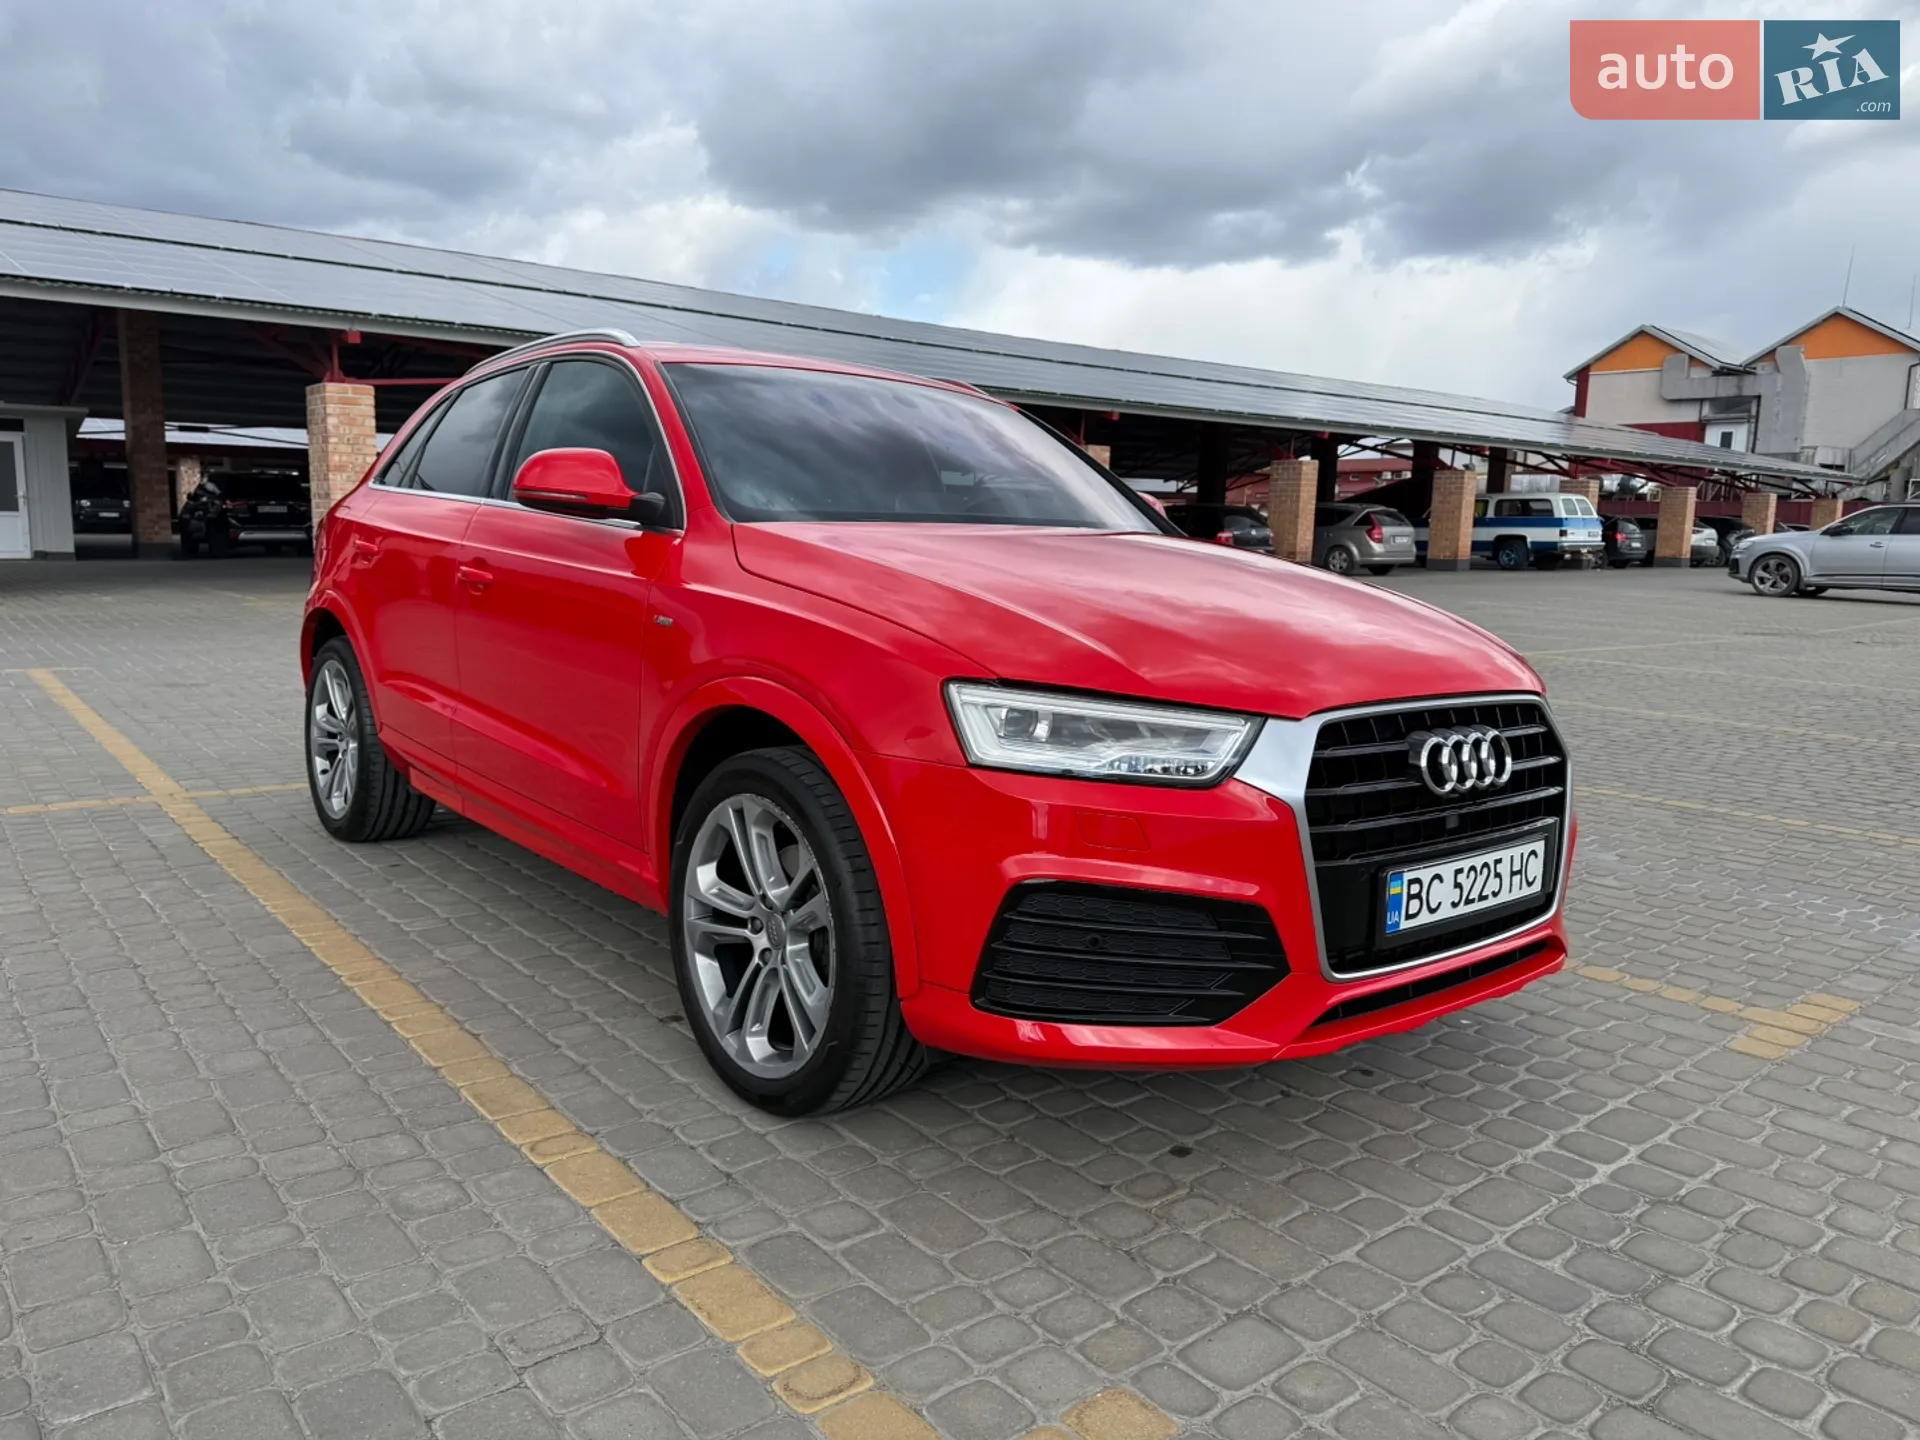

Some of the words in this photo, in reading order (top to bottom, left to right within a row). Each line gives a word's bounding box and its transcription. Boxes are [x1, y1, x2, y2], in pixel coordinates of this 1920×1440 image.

[1404, 874, 1444, 921] BC
[1450, 857, 1503, 909] 5225
[1508, 849, 1539, 894] HC
[1387, 910, 1400, 925] UA
